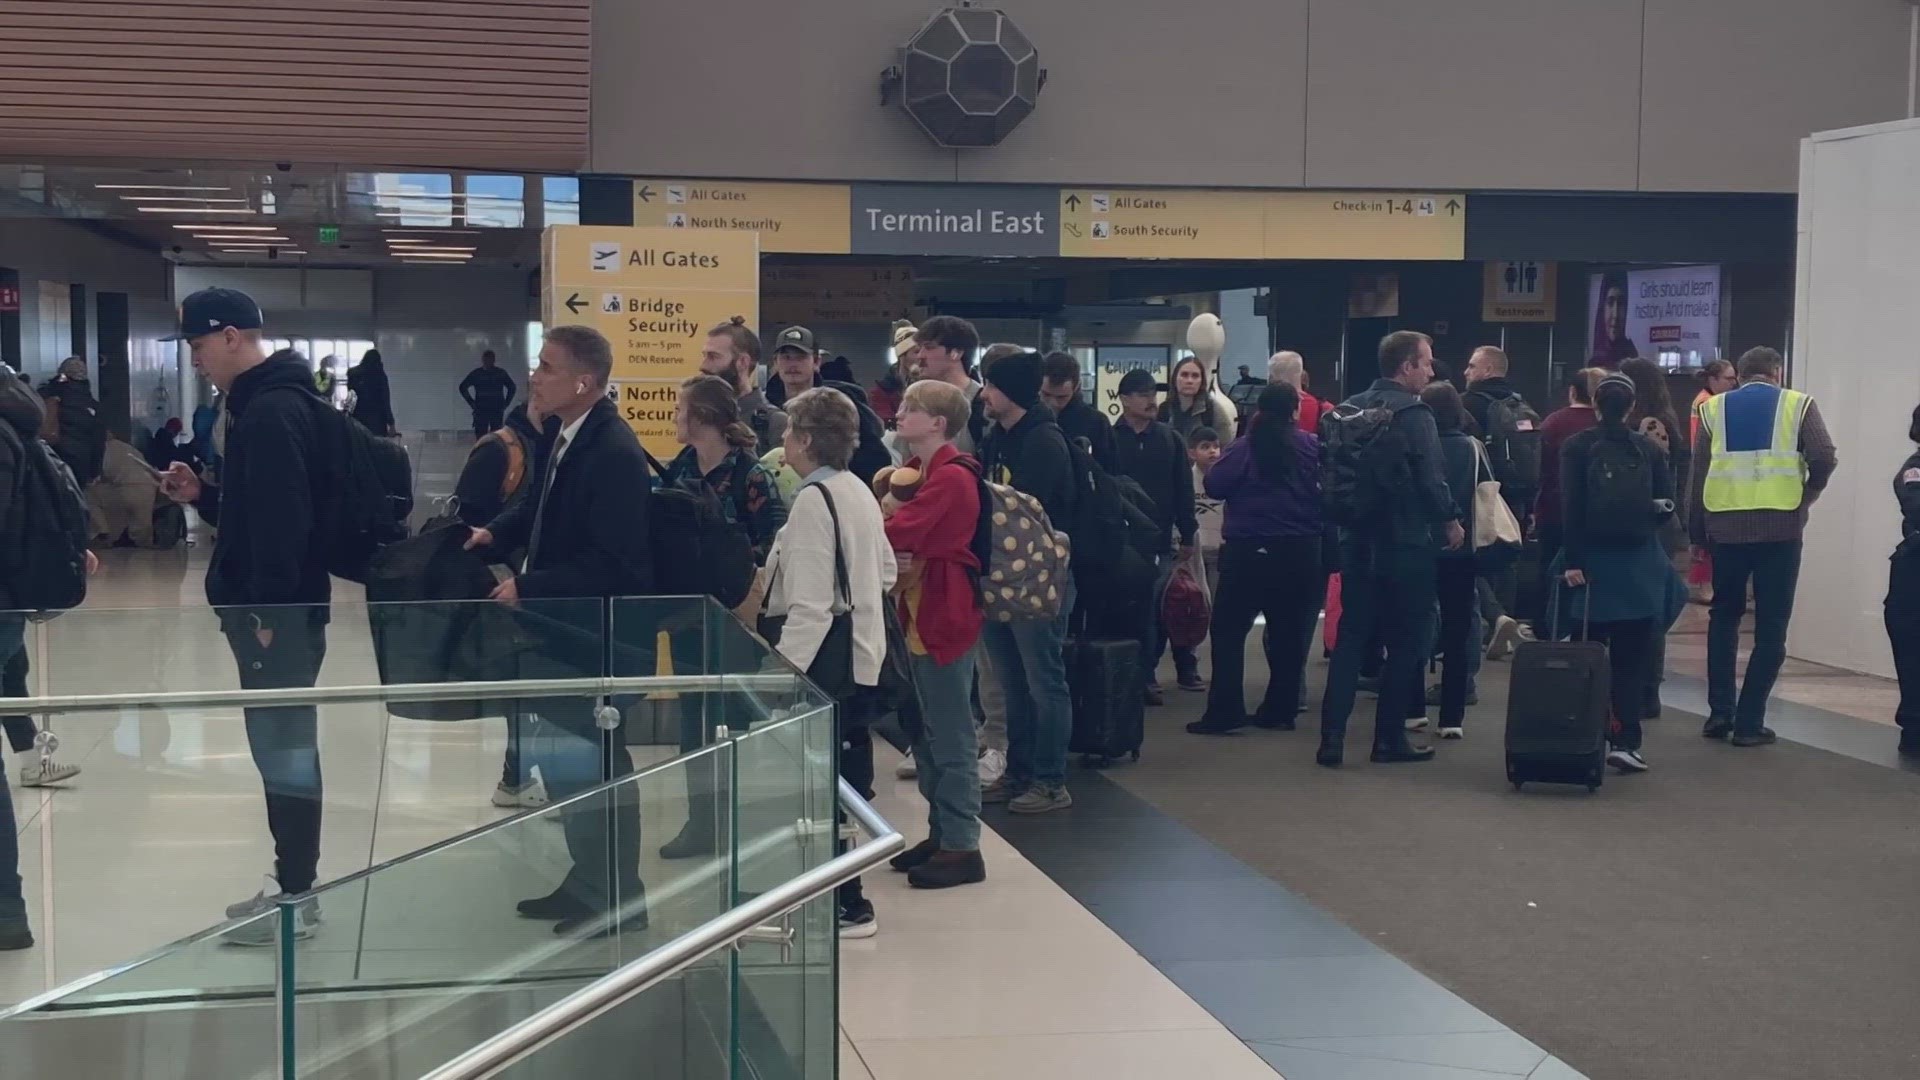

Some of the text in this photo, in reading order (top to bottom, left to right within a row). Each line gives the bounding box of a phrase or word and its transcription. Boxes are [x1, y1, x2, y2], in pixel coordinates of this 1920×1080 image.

[690, 189, 747, 201] All Gates
[1114, 198, 1168, 210] All Gates
[1333, 199, 1413, 215] Check-in 1-4
[691, 217, 782, 232] North Security
[866, 208, 1045, 235] Terminal East
[1114, 225, 1199, 240] South Security
[628, 249, 720, 268] All Gates
[1639, 279, 1714, 299] Girls should learn
[628, 298, 685, 317] Bridge
[1665, 301, 1683, 318] And
[1685, 301, 1710, 317] make
[628, 317, 699, 337] Security
[628, 339, 634, 349] 5
[636, 341, 650, 349] am
[660, 340, 666, 349] 5
[667, 341, 682, 351] pm
[628, 355, 684, 364] DEN Reserve
[627, 387, 677, 401] North
[627, 407, 679, 421] Secur
